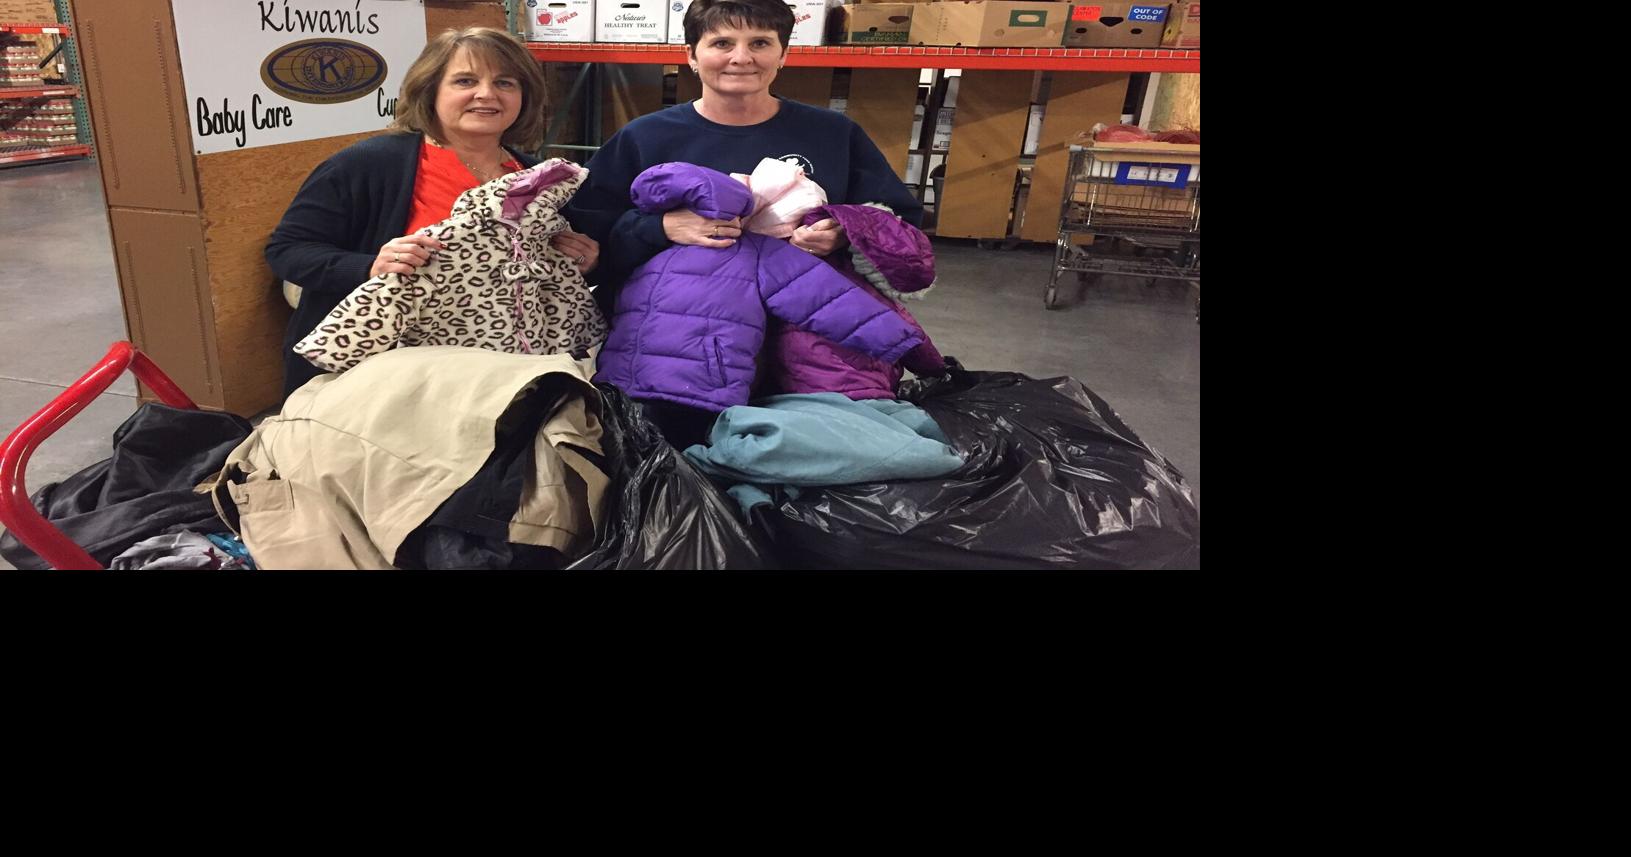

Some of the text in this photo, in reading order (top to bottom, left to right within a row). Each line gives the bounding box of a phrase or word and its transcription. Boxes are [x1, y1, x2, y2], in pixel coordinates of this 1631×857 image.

[258, 0, 380, 34] Kiwanis
[196, 94, 293, 147] Baby Care
